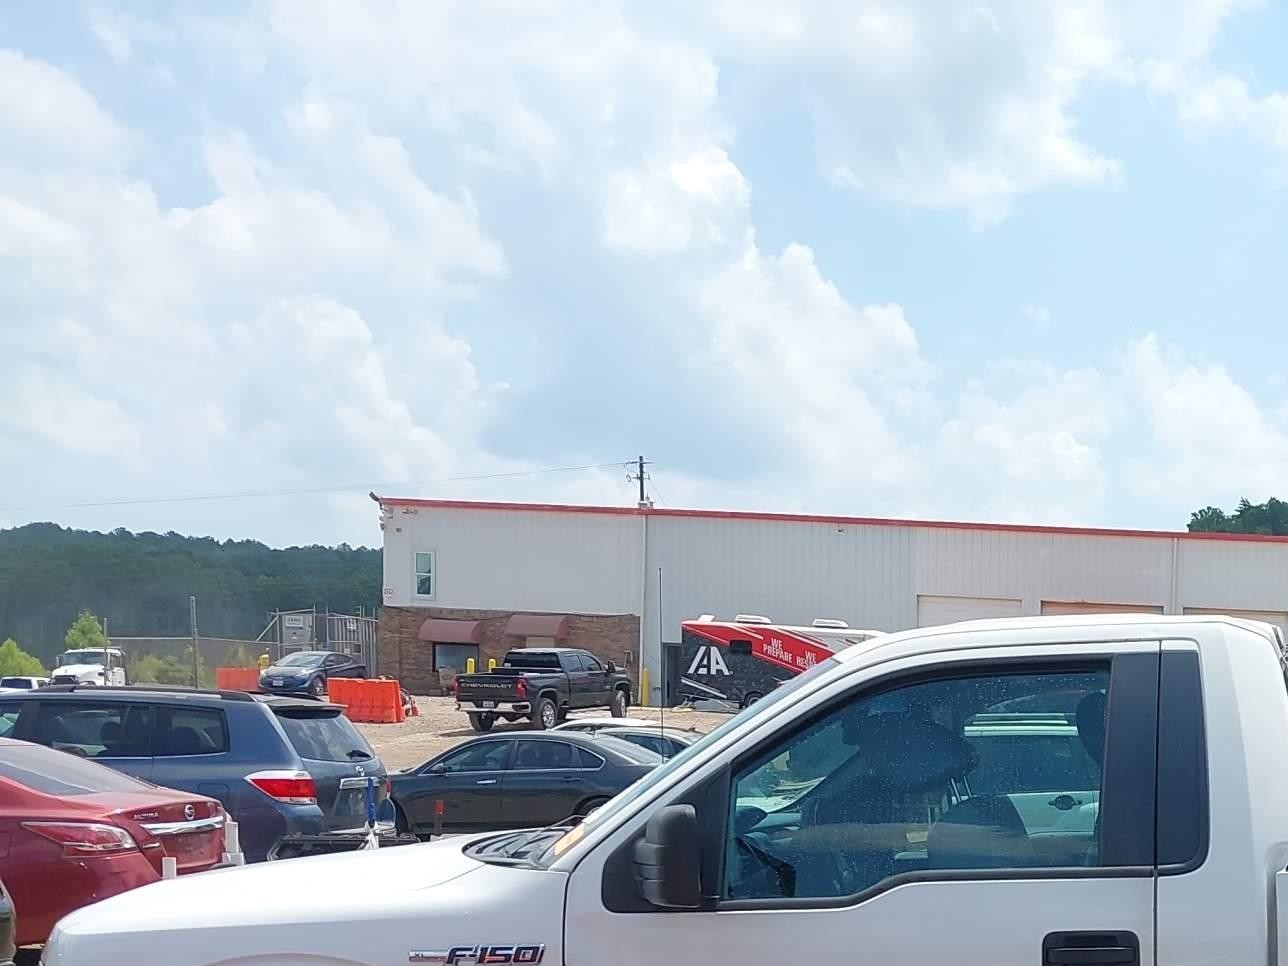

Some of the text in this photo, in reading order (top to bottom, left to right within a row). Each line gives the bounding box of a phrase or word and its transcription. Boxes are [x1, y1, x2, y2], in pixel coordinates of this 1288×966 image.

[771, 637, 784, 649] WE
[762, 643, 793, 663] PREPARE
[805, 650, 817, 664] WE
